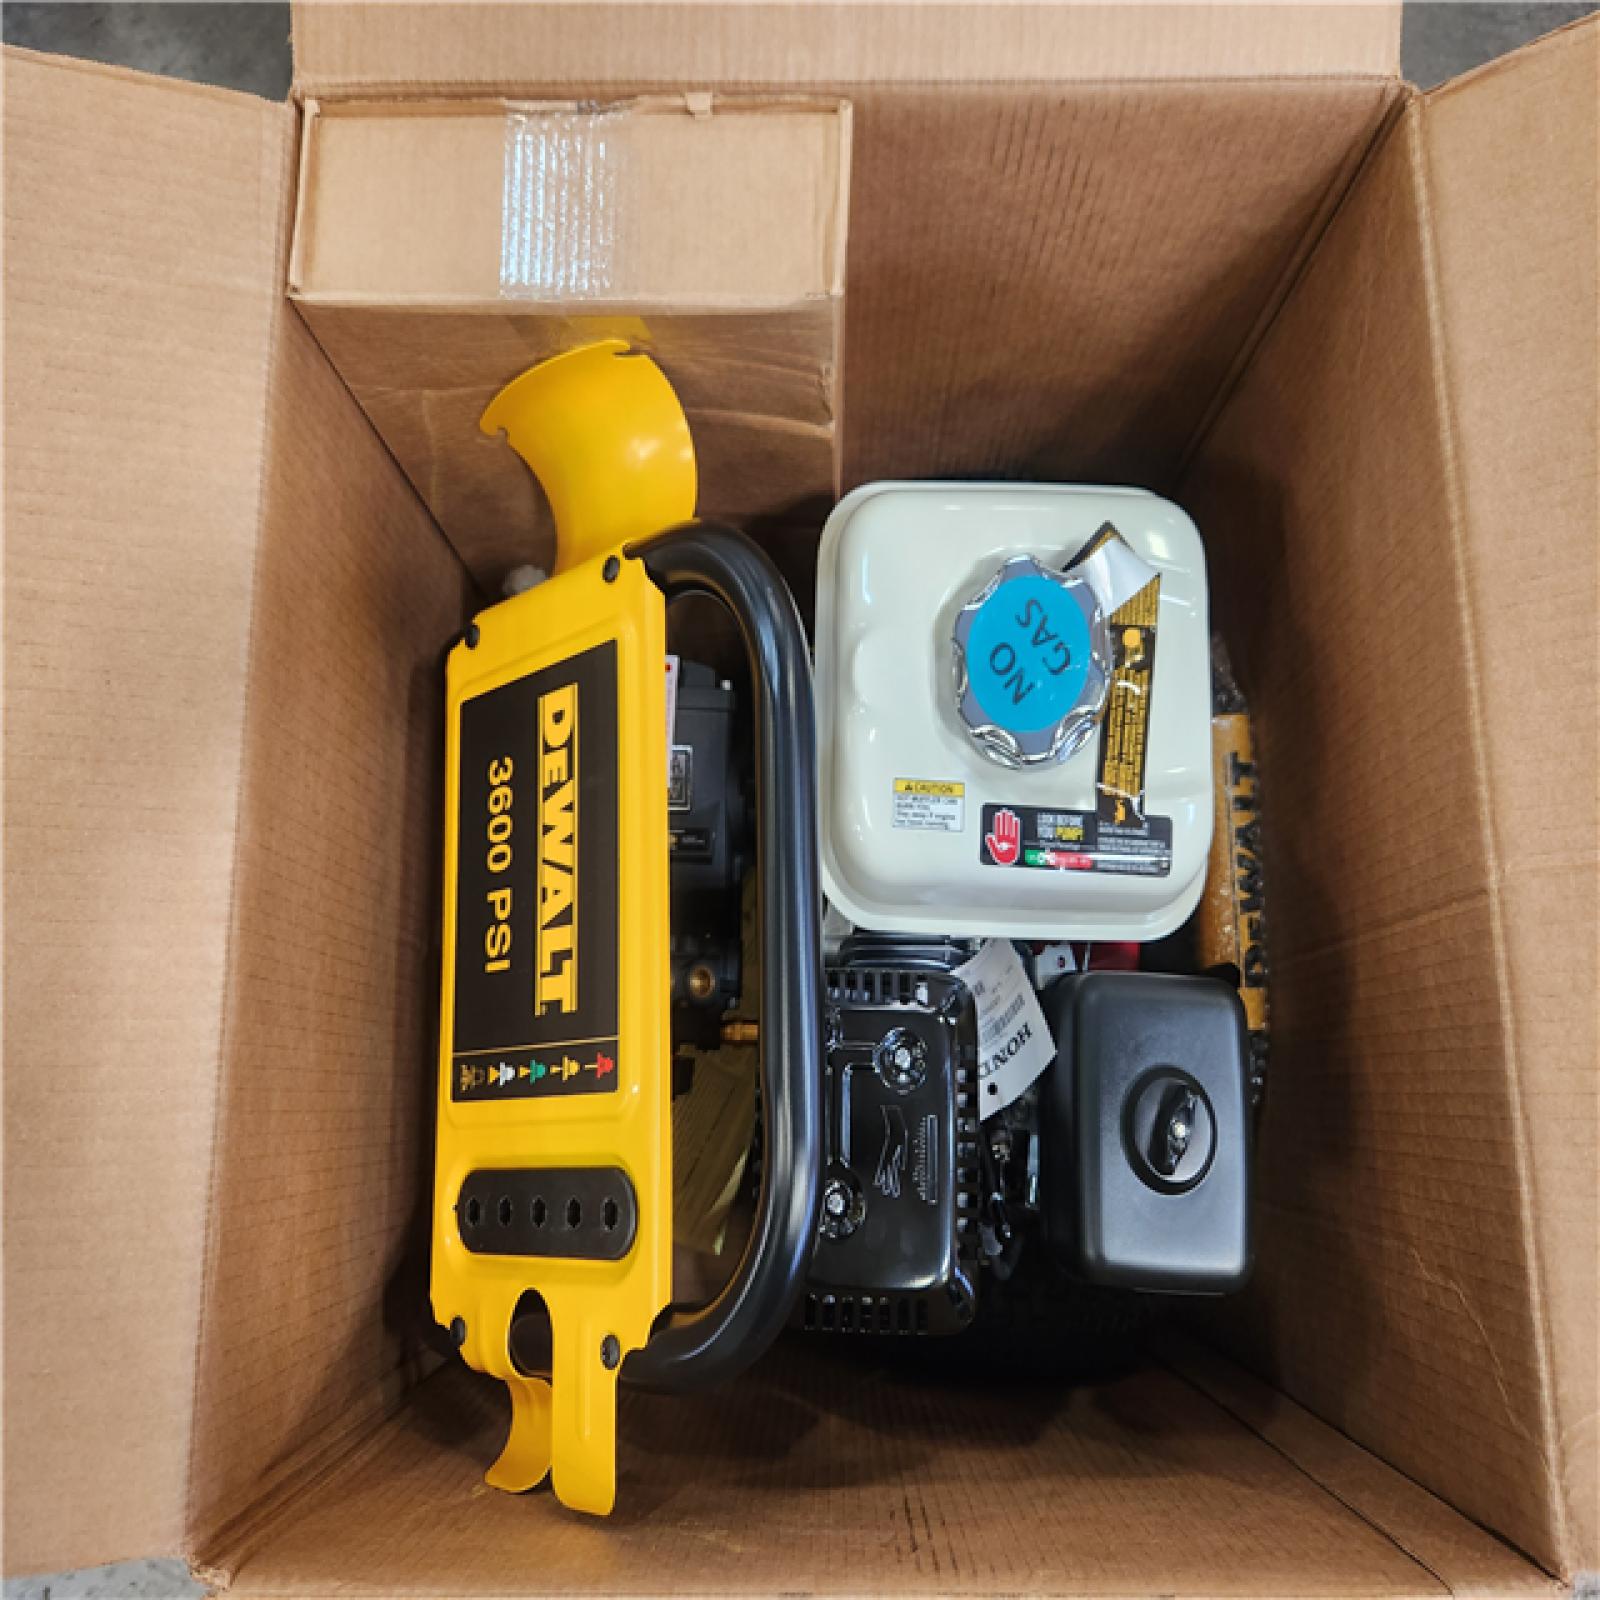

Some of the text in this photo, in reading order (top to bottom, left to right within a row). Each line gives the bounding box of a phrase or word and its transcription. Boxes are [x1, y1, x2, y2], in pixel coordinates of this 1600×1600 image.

[989, 642, 1036, 706] NO
[1014, 598, 1071, 676] GAS
[484, 756, 515, 974] 3600 PSI
[536, 682, 579, 1017] DEWALT
